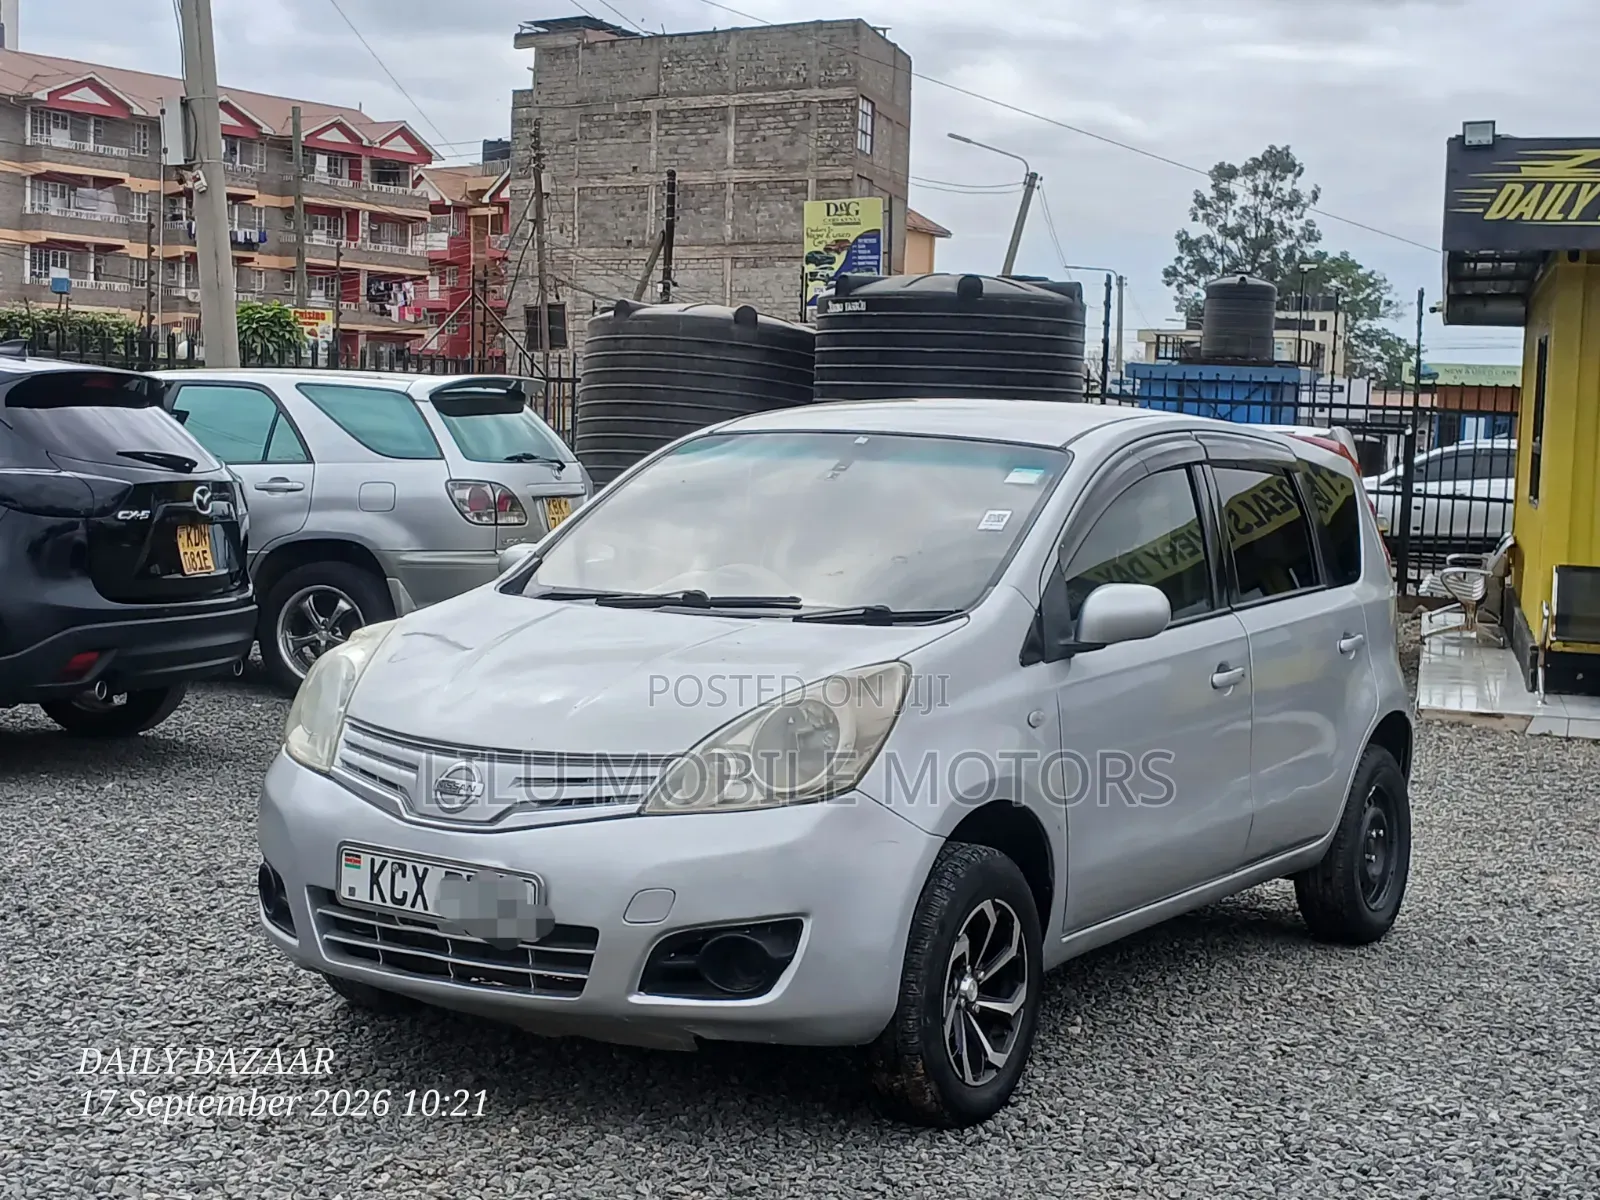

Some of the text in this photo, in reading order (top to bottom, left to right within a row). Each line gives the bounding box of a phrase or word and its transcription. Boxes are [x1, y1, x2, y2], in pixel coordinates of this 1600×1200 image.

[1484, 183, 1600, 220] DAILY
[117, 509, 151, 521] CX-5
[438, 779, 477, 794] NISSAN
[369, 857, 430, 911] KCX
